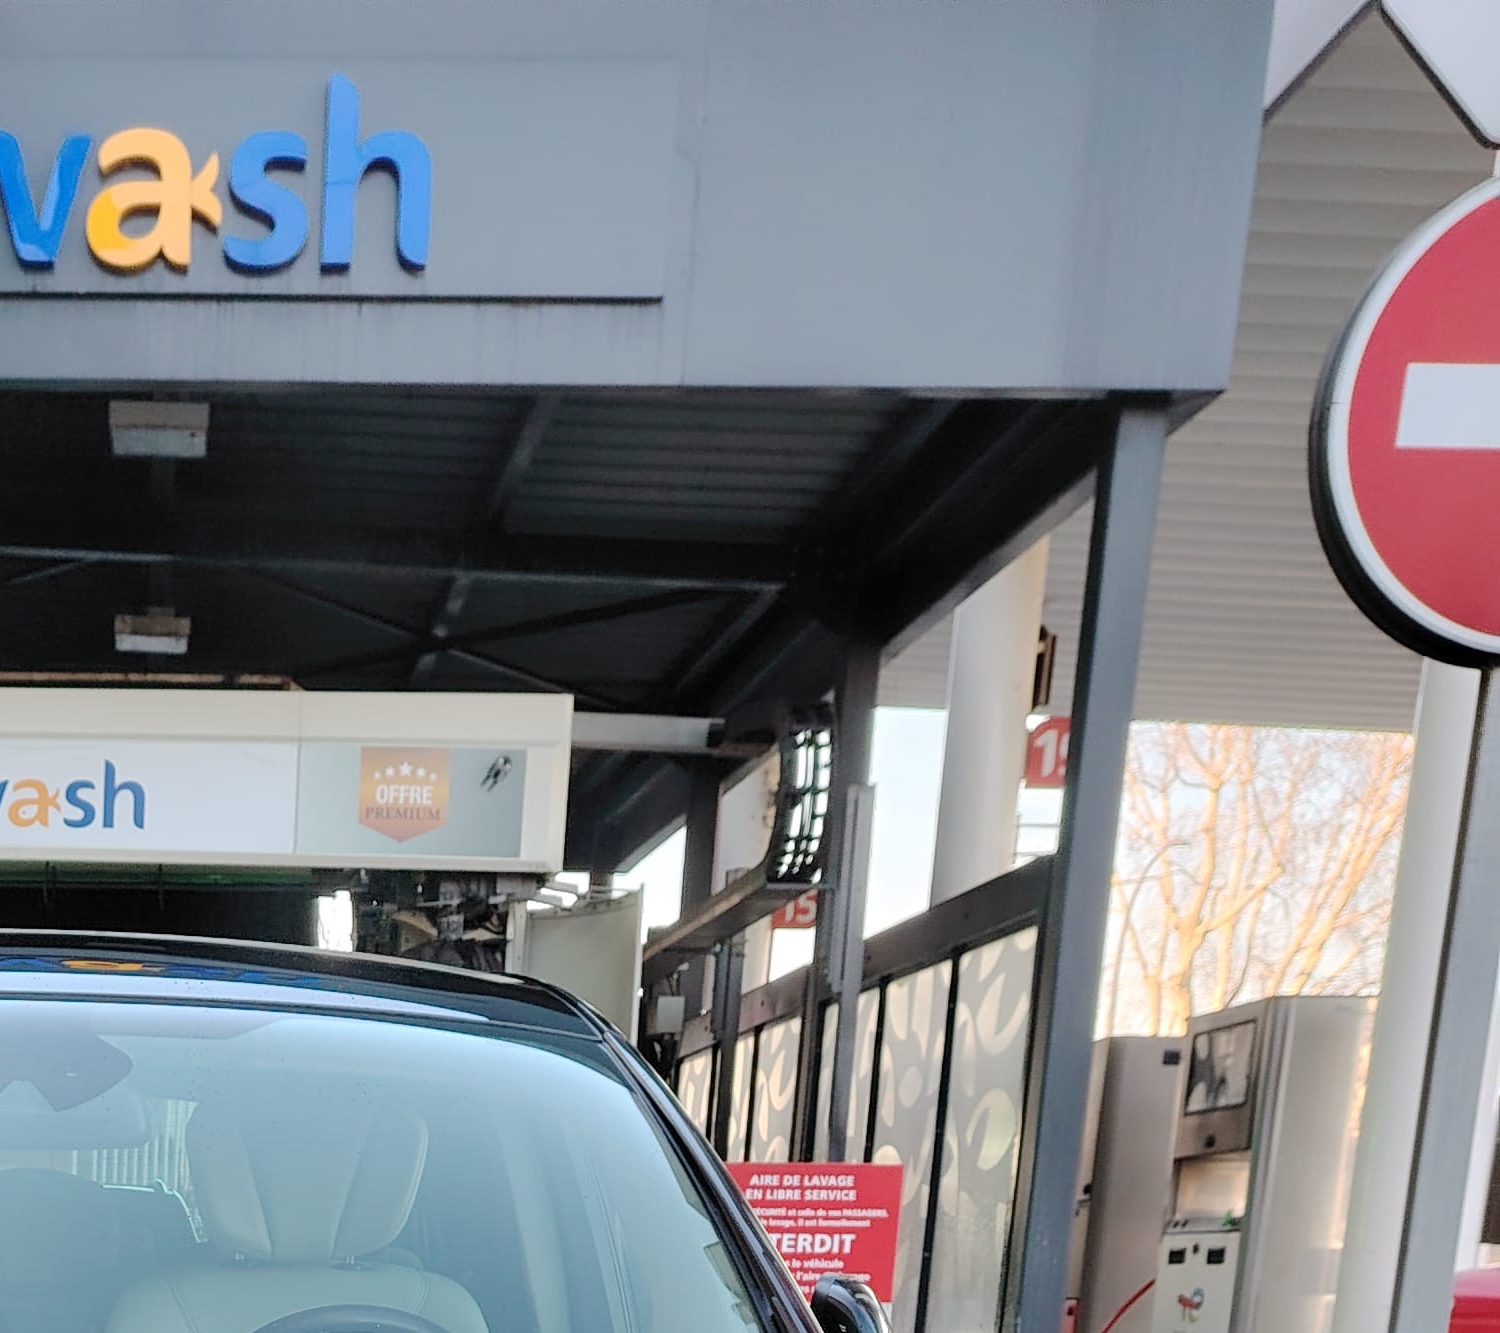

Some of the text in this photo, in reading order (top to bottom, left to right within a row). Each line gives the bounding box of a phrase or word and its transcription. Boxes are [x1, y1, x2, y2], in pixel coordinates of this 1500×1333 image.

[375, 784, 434, 805] OFFRE
[364, 806, 441, 821] PREMIUM
[750, 1174, 855, 1187] AIRE DE LAVAGE
[745, 1188, 857, 1201] EN LIBRE SERVICE
[769, 1232, 856, 1254] TERDIT
[803, 1258, 845, 1269] véhicule
